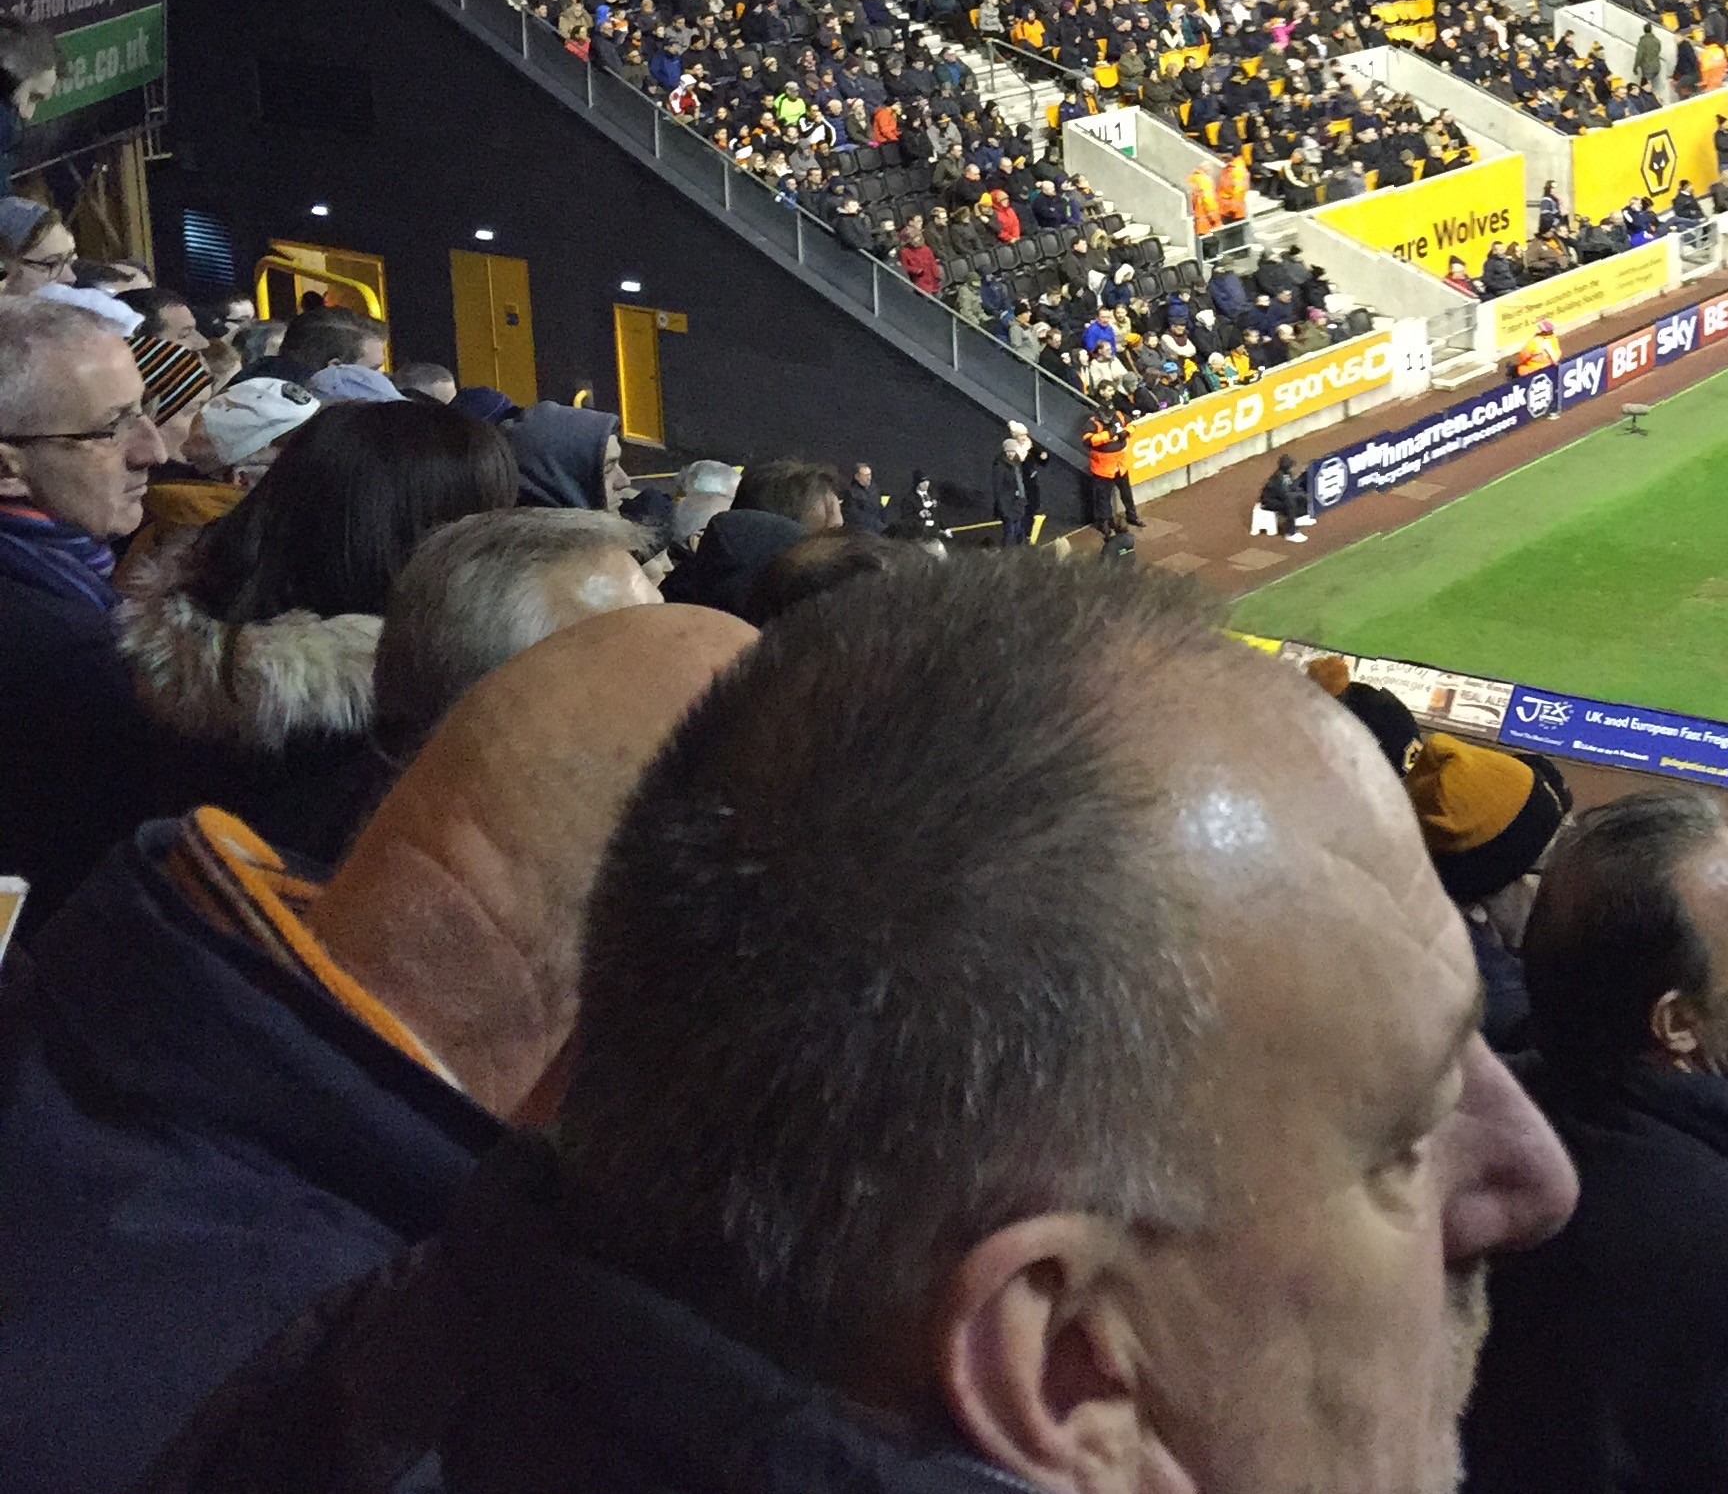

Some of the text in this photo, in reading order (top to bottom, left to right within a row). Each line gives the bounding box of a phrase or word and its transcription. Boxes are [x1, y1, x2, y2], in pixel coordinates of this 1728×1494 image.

[1433, 208, 1511, 250] Wolves
[1657, 315, 1698, 355] sky
[1563, 333, 1652, 398] sky BET
[1585, 710, 1603, 725] UK
[1630, 717, 1680, 737] European
[1679, 726, 1702, 742] Fast
